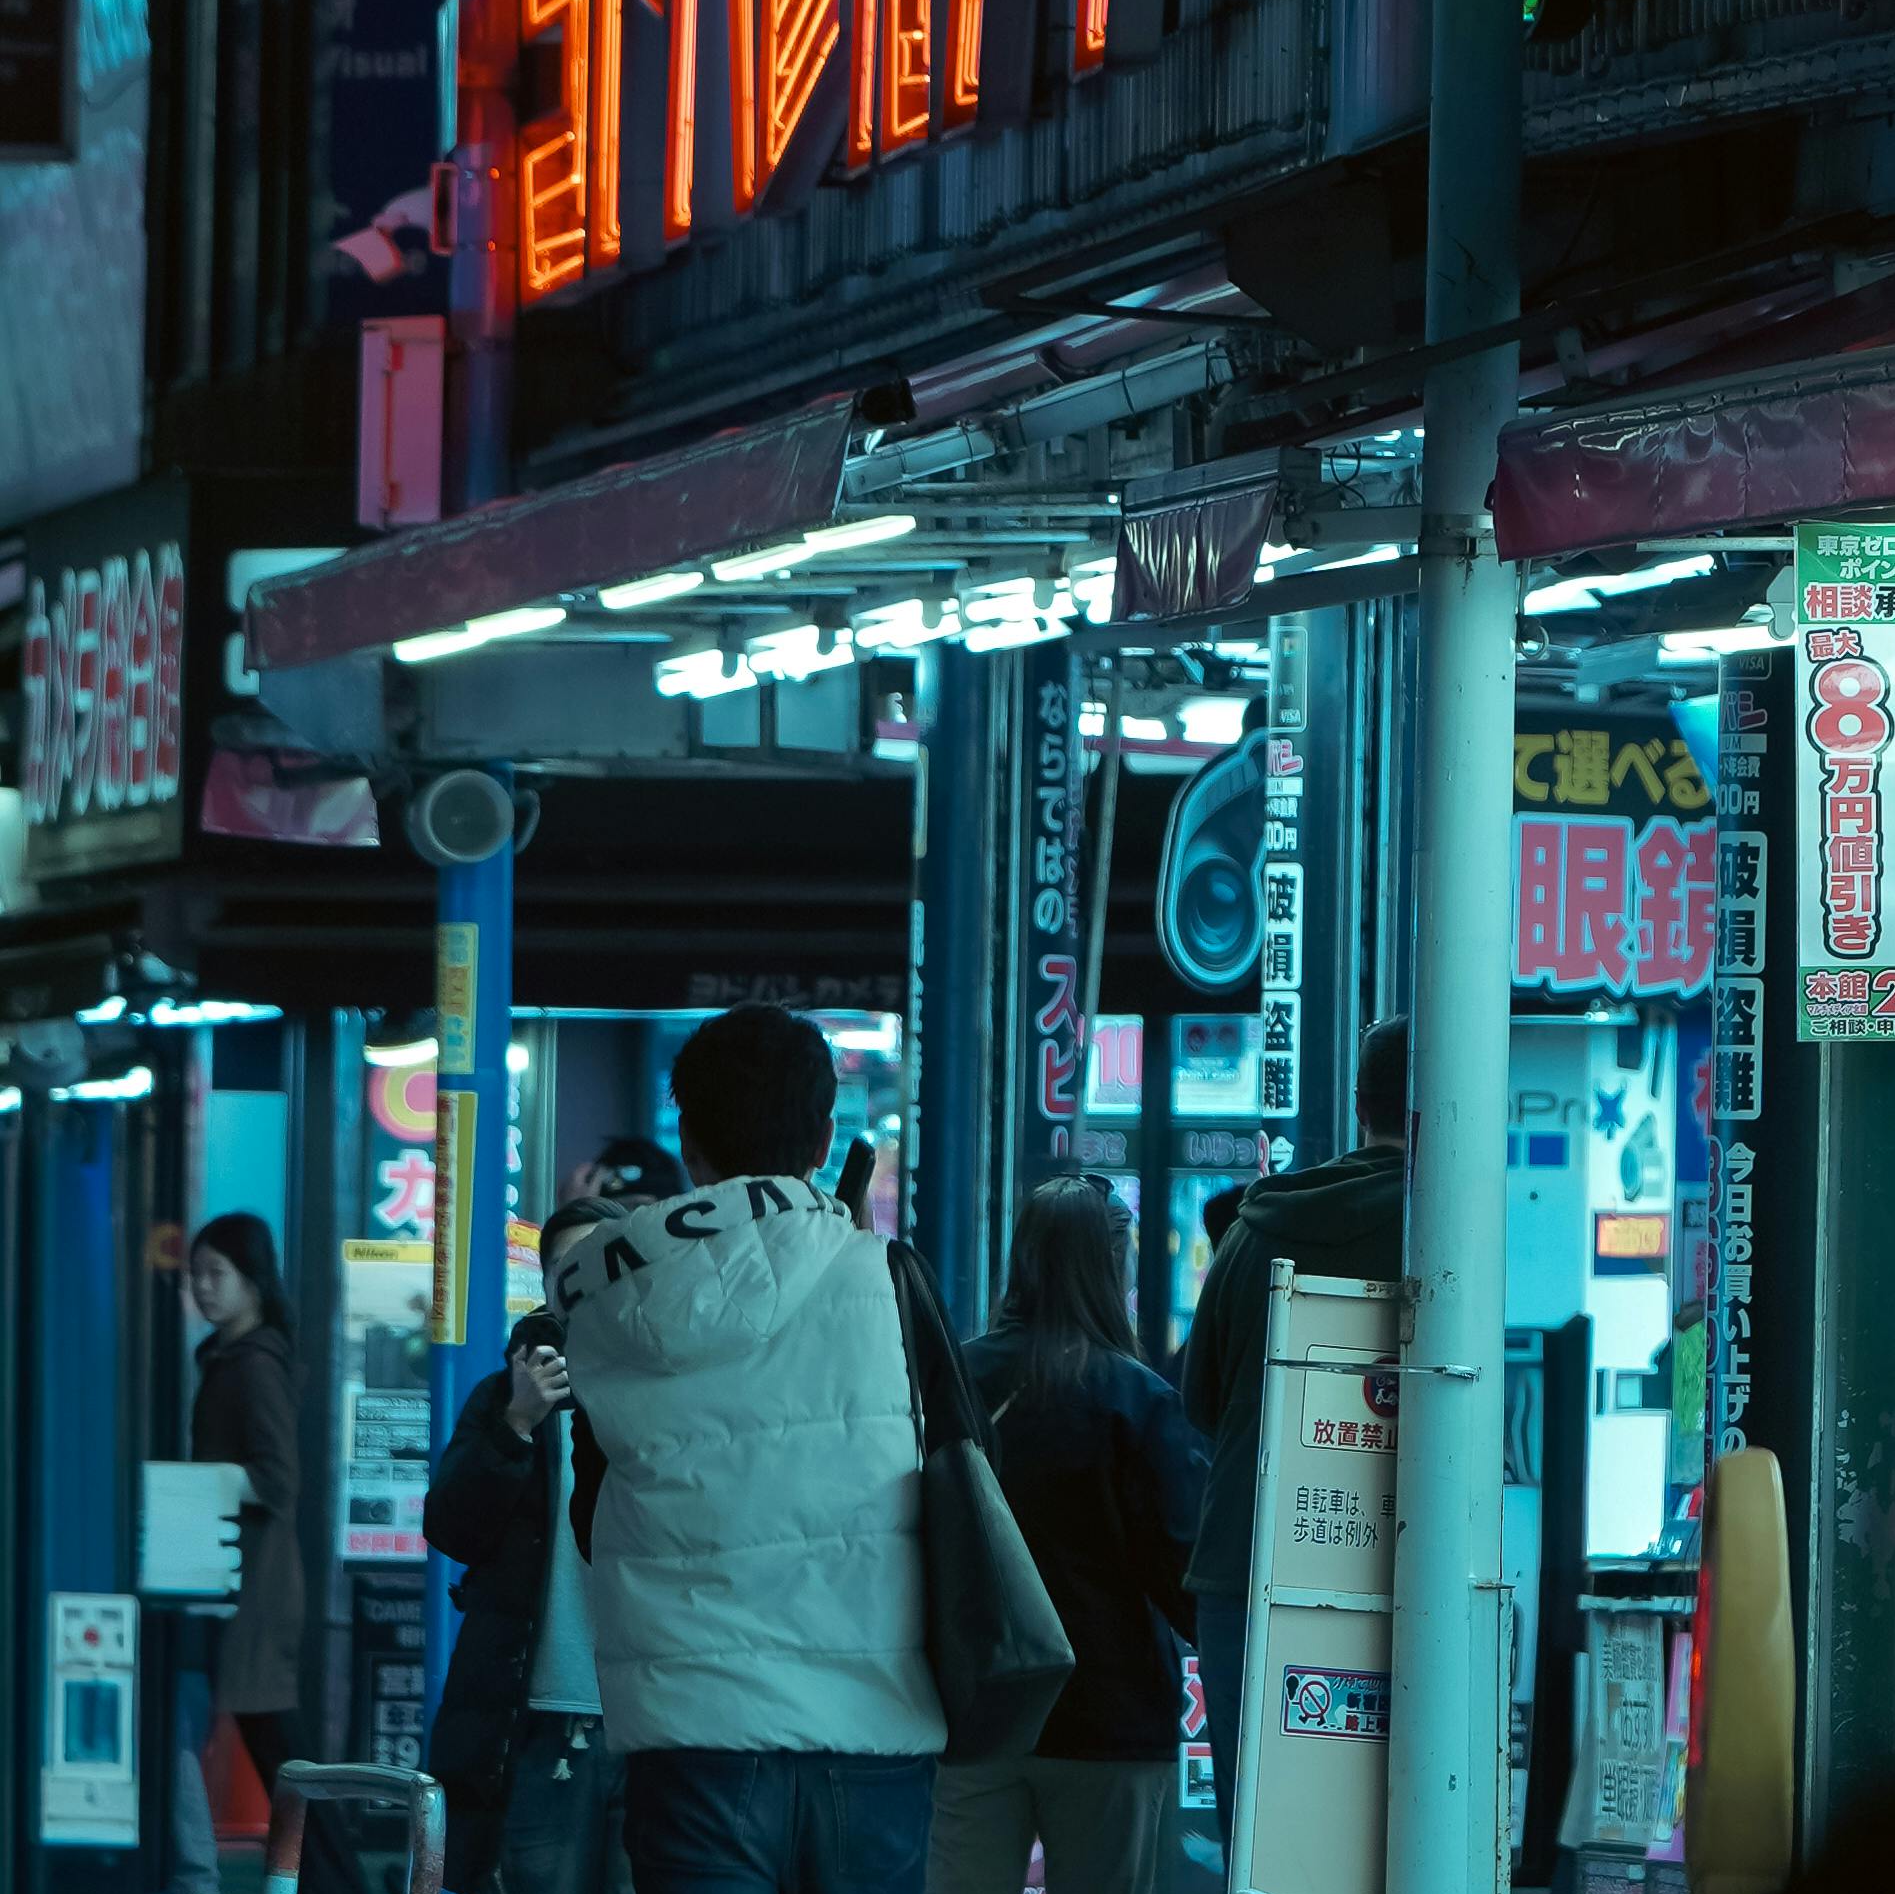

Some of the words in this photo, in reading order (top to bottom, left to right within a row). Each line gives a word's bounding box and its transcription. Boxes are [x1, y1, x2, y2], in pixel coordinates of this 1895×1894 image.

[1808, 630, 1861, 660] 最大
[1717, 841, 1761, 967] 破損
[1807, 971, 1868, 1000] 本館
[1715, 987, 1759, 1111] 盗難
[1295, 1484, 1369, 1519] 自転車は、
[1292, 1517, 1380, 1550] 歩道は例外
